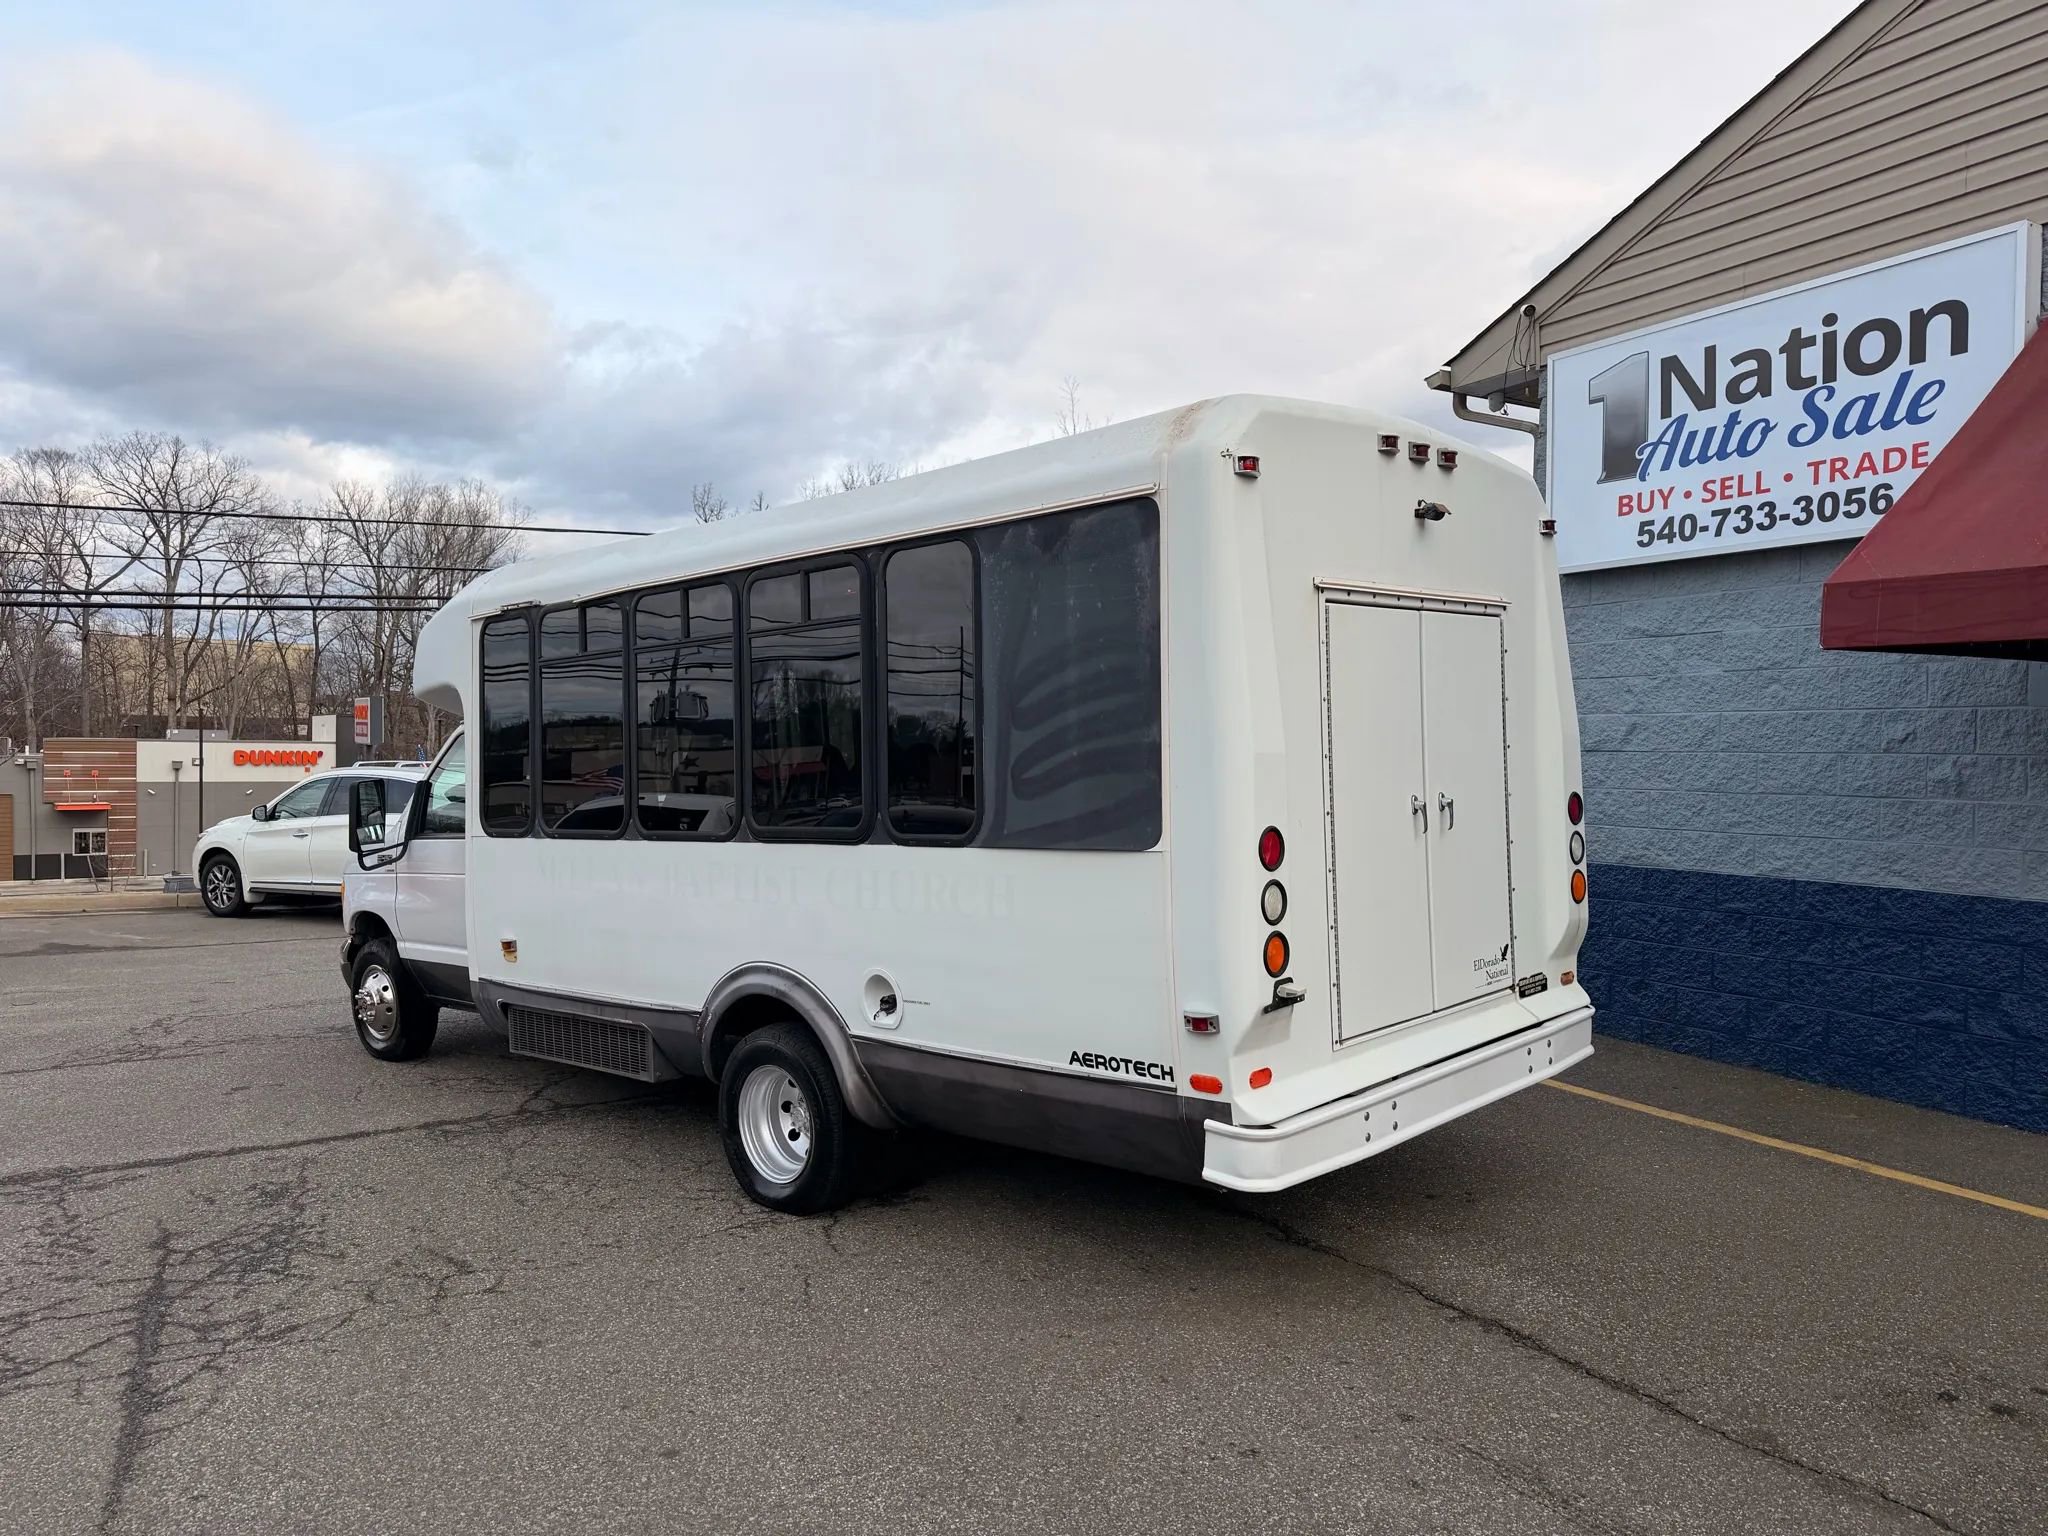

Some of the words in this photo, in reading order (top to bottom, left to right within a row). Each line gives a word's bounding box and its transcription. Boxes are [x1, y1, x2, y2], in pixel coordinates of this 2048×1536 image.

[1636, 408, 1778, 483] Auto
[1787, 369, 1946, 448] Sale
[1617, 486, 1675, 517] BUY
[1701, 471, 1771, 504] SELL
[1807, 441, 1930, 486] TRADE
[1636, 482, 1894, 548] 540-733-3056
[233, 749, 323, 767] DUNKIN'
[1069, 1050, 1174, 1082] AEROTECH
